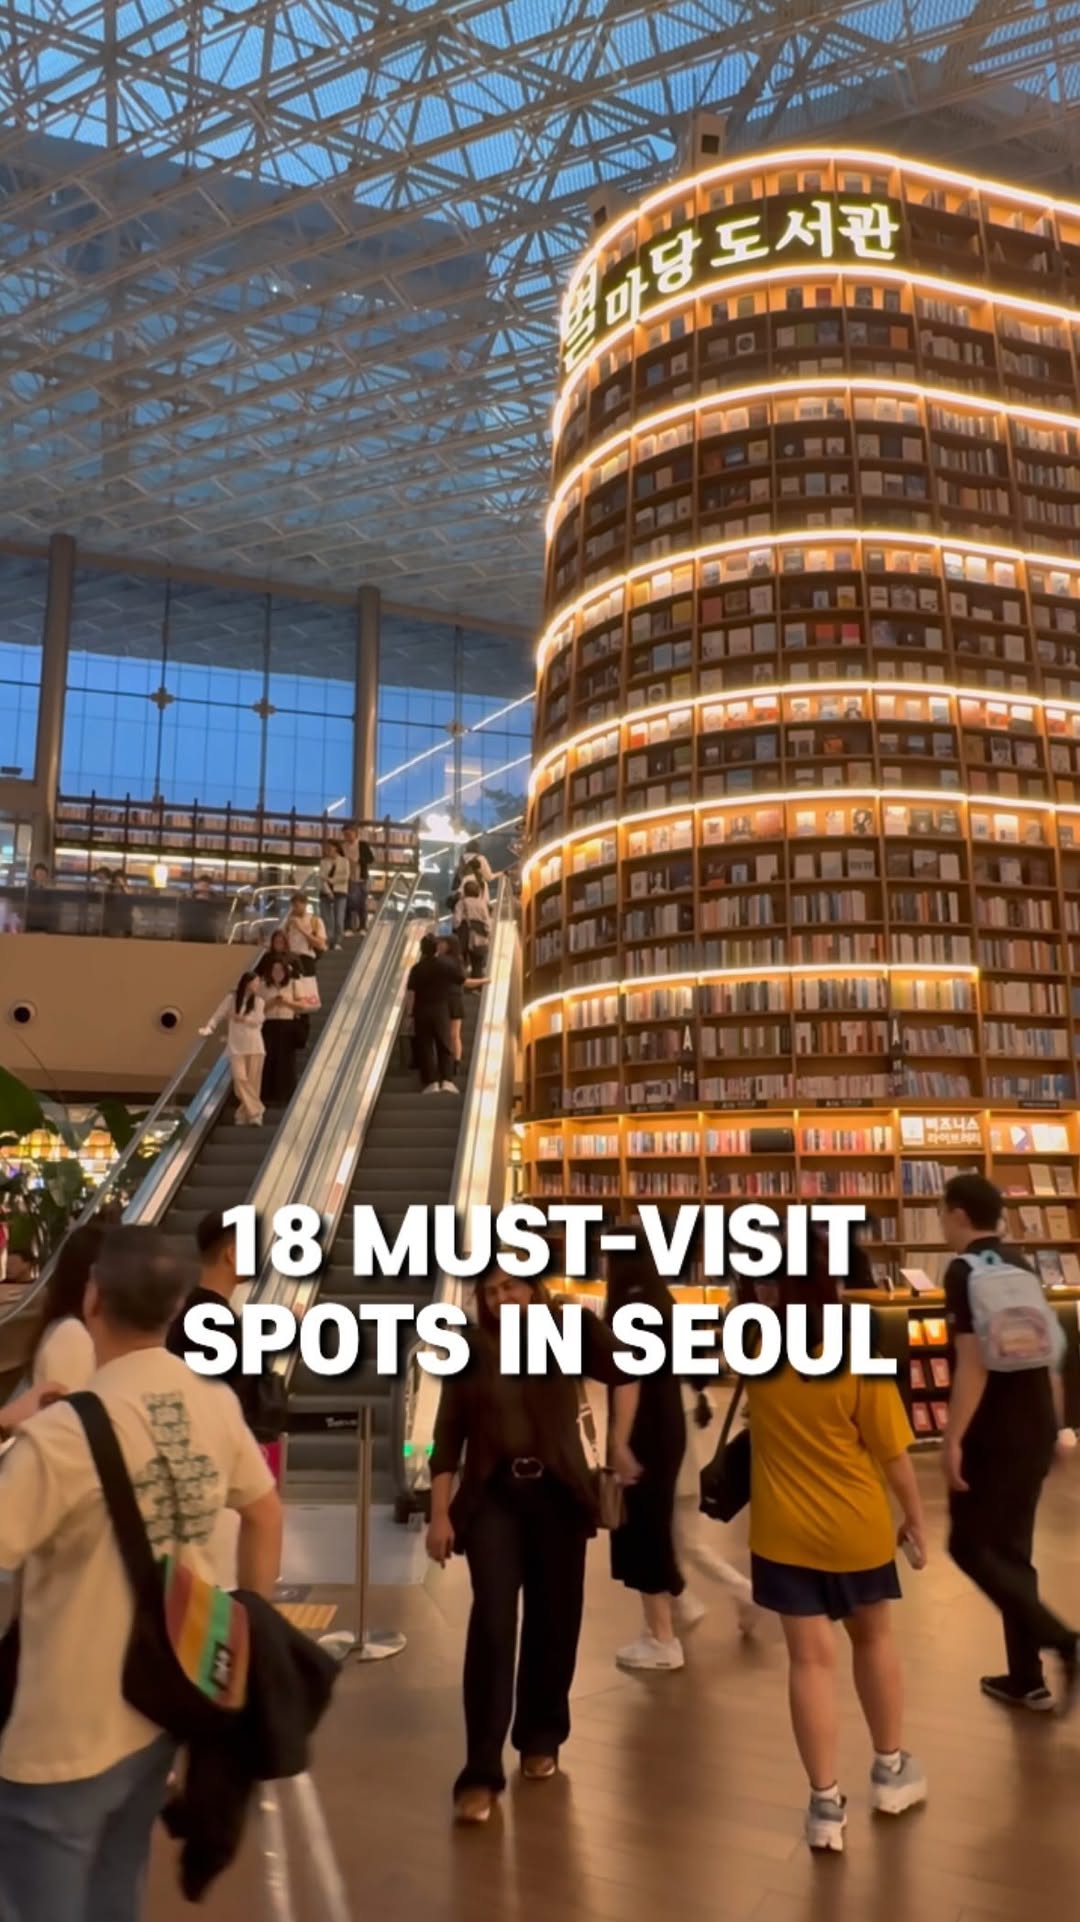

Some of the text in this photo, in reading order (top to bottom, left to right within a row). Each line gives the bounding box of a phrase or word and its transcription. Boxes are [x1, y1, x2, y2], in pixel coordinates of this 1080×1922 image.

[562, 200, 899, 374] 별마당 도서관
[925, 1116, 980, 1131] 비즈니스
